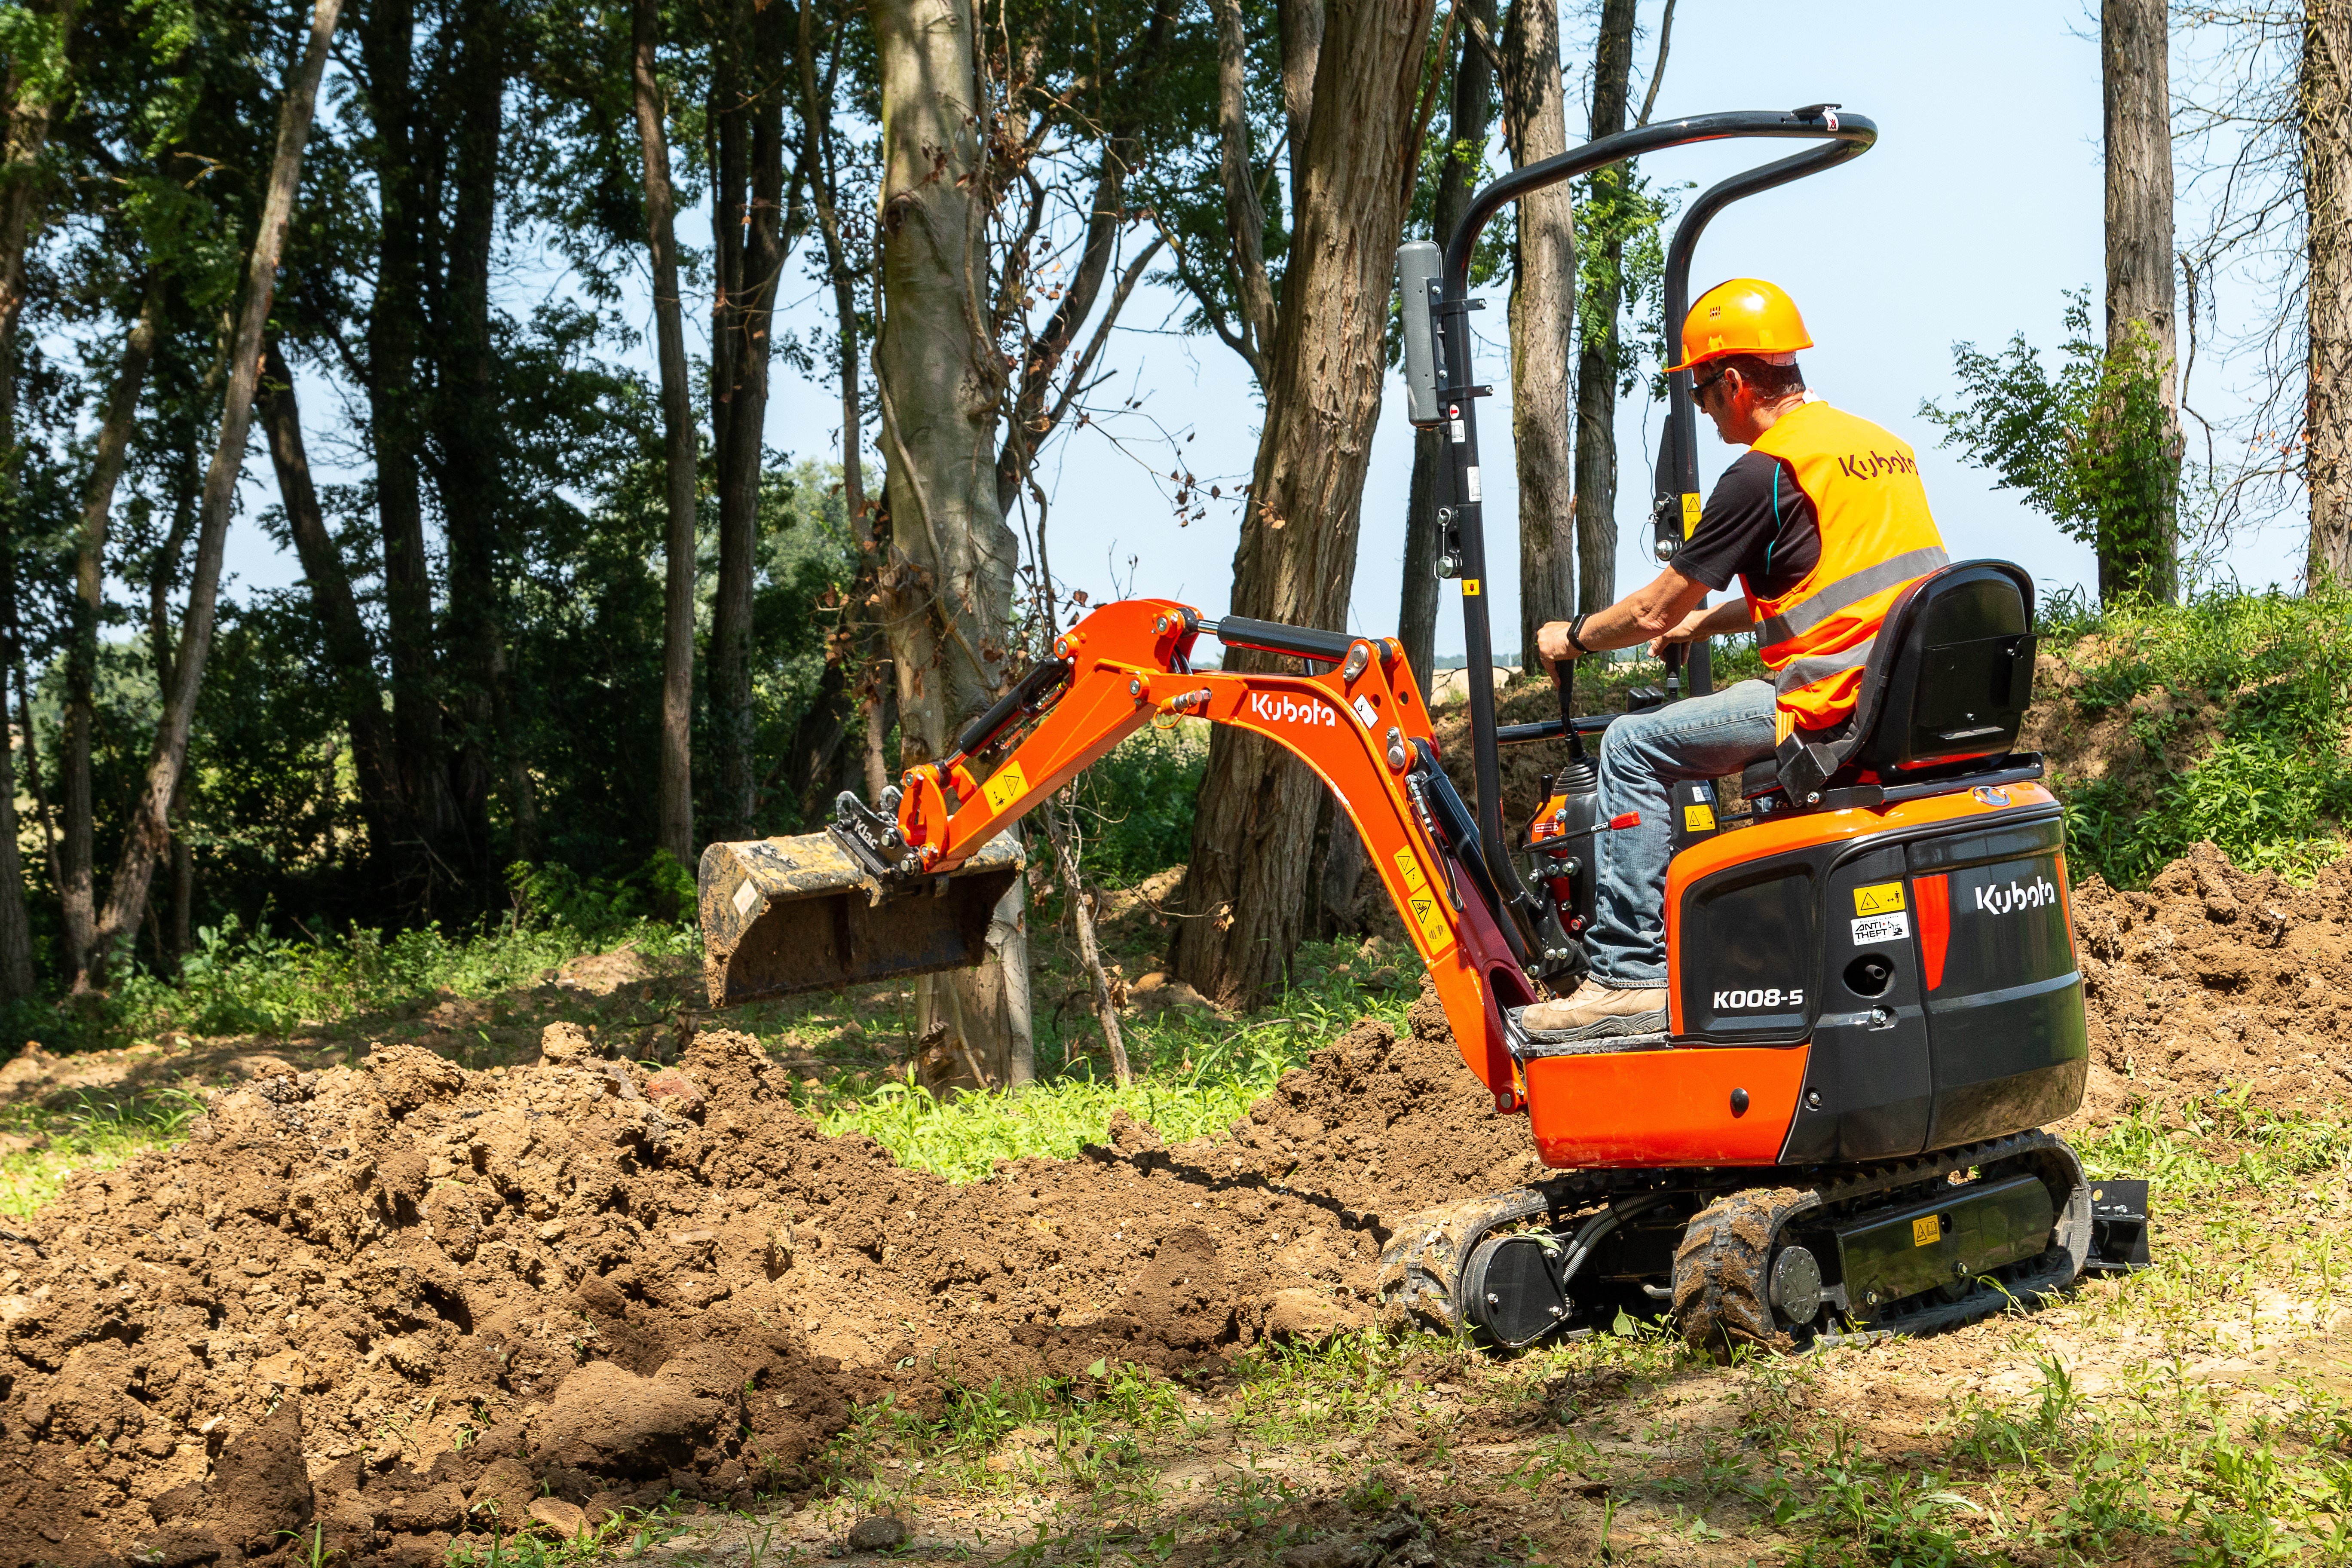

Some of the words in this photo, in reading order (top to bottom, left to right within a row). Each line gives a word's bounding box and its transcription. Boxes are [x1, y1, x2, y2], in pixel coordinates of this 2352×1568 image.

[1838, 450, 1919, 481] Kubota
[1252, 693, 1335, 726] Kubota
[1975, 876, 2055, 915] Kubota
[1855, 922, 1881, 932] ANTI
[1855, 928, 1887, 939] THEFT
[1713, 989, 1803, 1009] K008-5
